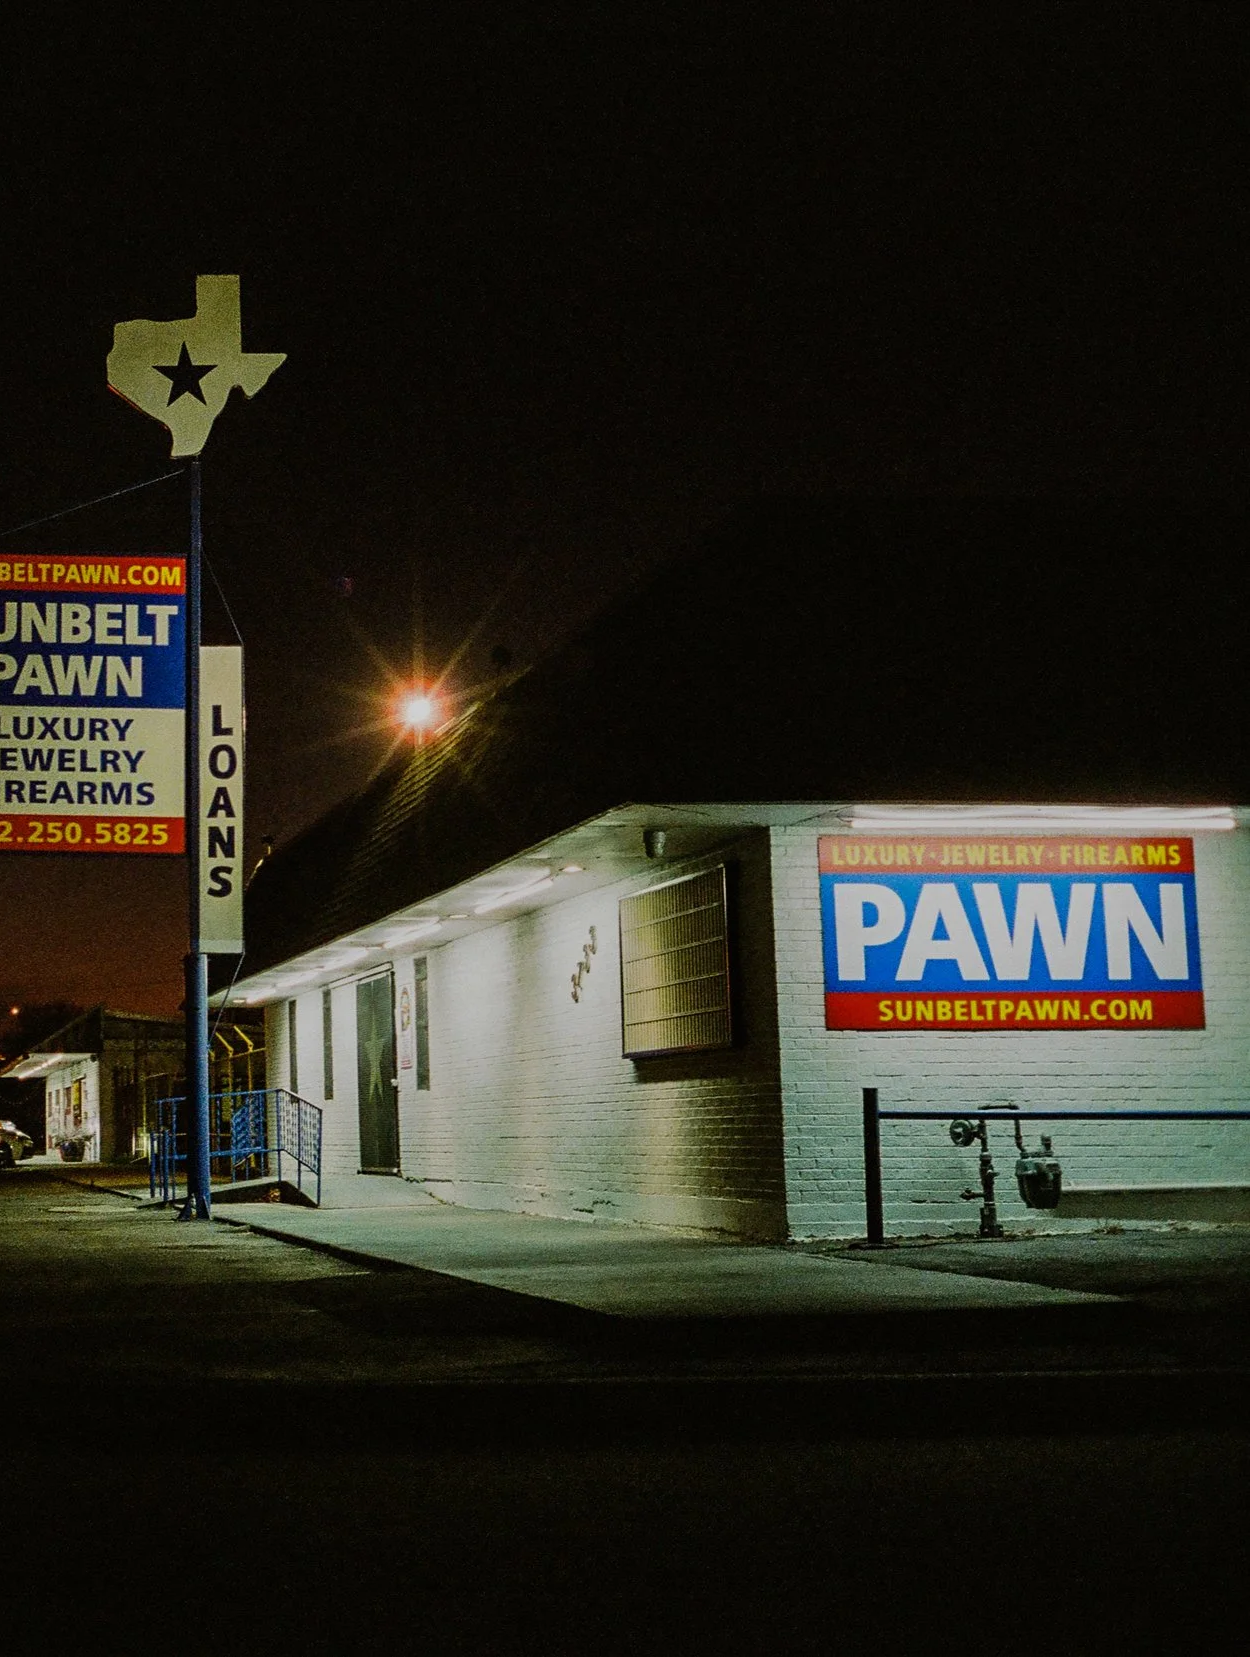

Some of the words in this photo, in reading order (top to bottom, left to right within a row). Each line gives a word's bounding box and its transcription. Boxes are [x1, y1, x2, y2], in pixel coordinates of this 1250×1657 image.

[208, 704, 238, 898] LOANS
[831, 844, 924, 866] LUXURY
[940, 844, 1043, 866] JEWELRY
[1059, 844, 1181, 866] FIREARMS
[833, 882, 1190, 981] PAWN
[878, 998, 1154, 1021] SUNBELTPAWN.COM
